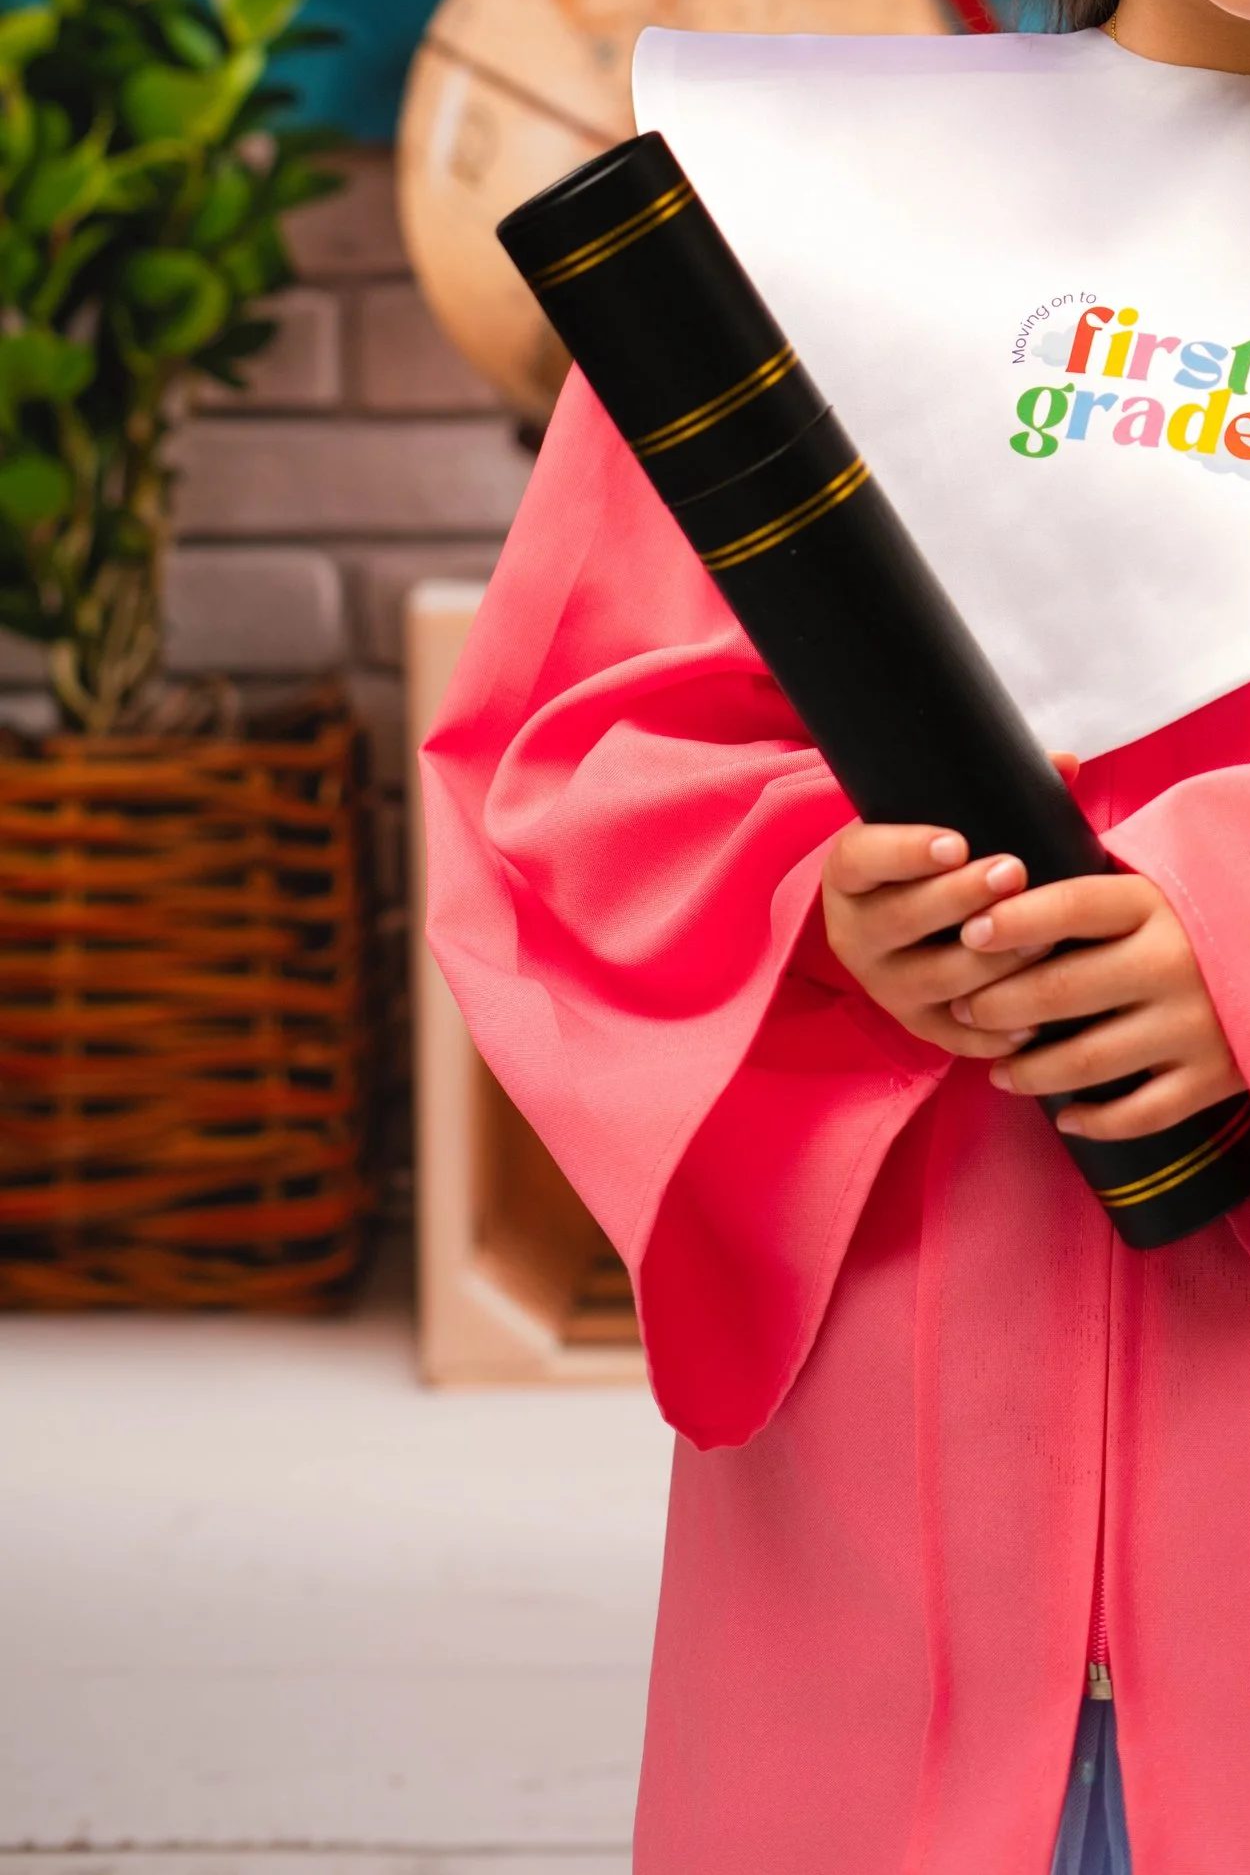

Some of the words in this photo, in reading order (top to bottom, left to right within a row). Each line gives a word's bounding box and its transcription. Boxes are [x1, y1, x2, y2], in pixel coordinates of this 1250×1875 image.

[1011, 304, 1050, 364] Moving
[1051, 294, 1074, 308] on
[1079, 291, 1097, 304] to
